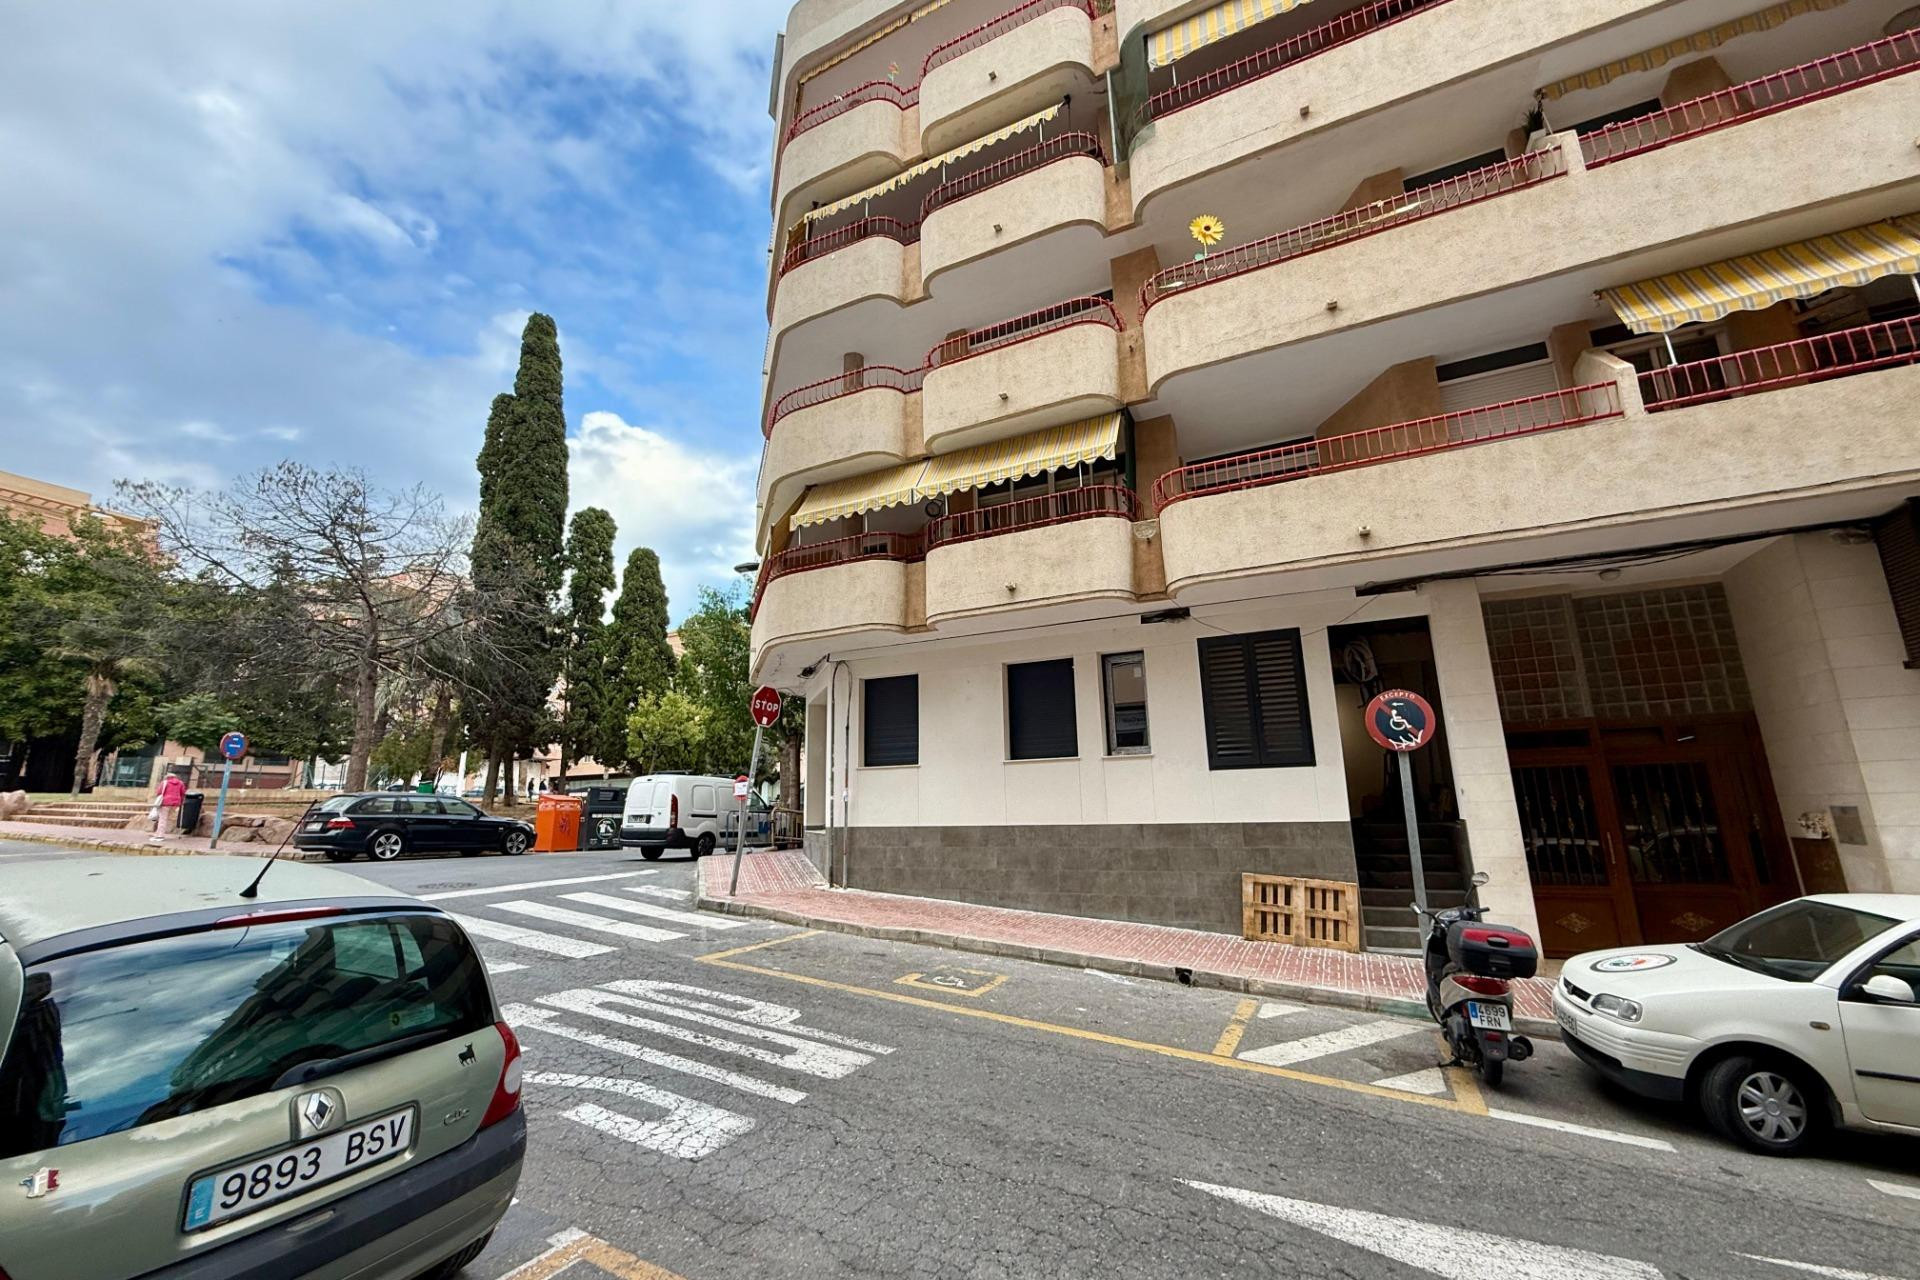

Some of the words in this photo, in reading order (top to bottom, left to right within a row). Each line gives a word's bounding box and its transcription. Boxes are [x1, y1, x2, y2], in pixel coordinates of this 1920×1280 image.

[1380, 691, 1415, 701] EXCEPTO
[755, 699, 779, 712] STOP
[1478, 1005, 1506, 1017] 4699
[1480, 1015, 1502, 1028] FRN
[220, 1147, 322, 1209] 9893
[345, 1115, 406, 1166] BSV
